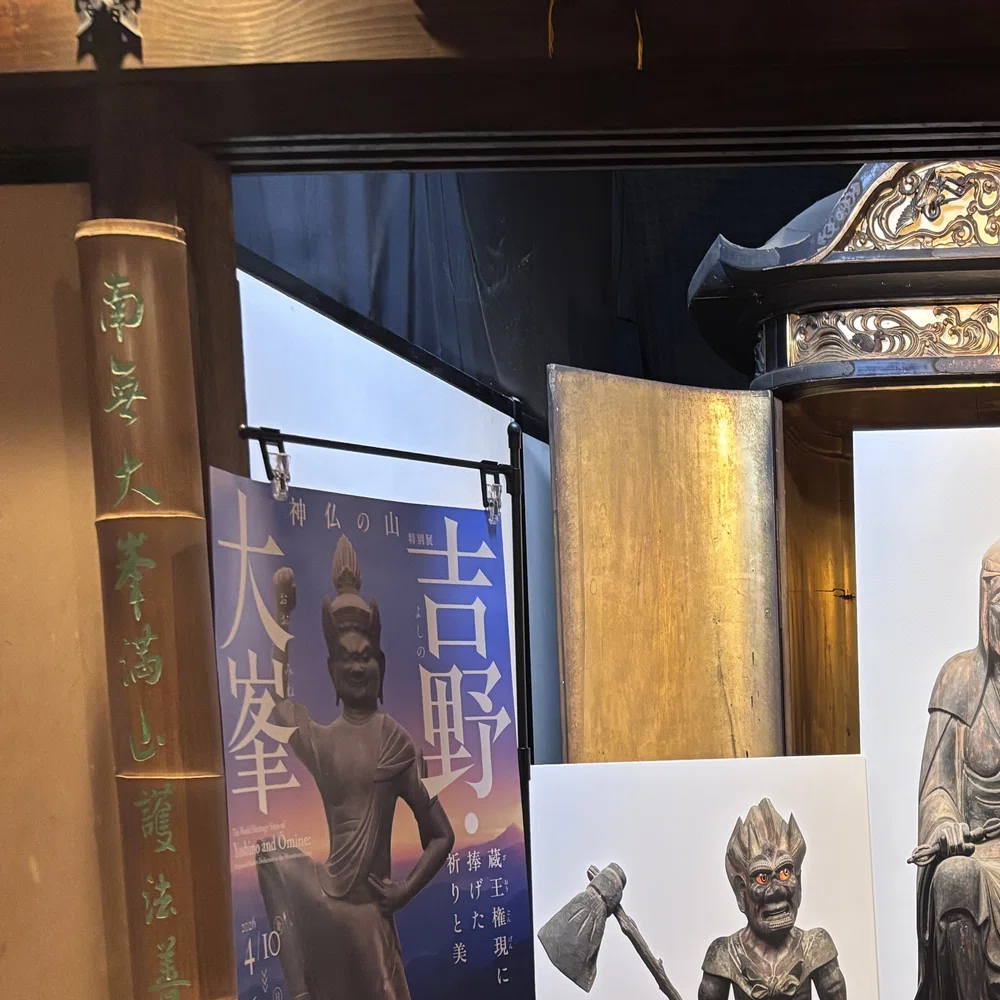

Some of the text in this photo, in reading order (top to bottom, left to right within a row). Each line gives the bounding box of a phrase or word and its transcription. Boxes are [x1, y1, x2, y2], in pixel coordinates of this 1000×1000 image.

[289, 497, 401, 537] 神仏の山
[217, 489, 301, 816] 大峯
[261, 835, 276, 852] and
[466, 850, 485, 930] 捧げた
[446, 852, 468, 965] 祈りと美
[487, 848, 509, 984] 蔵王権現に
